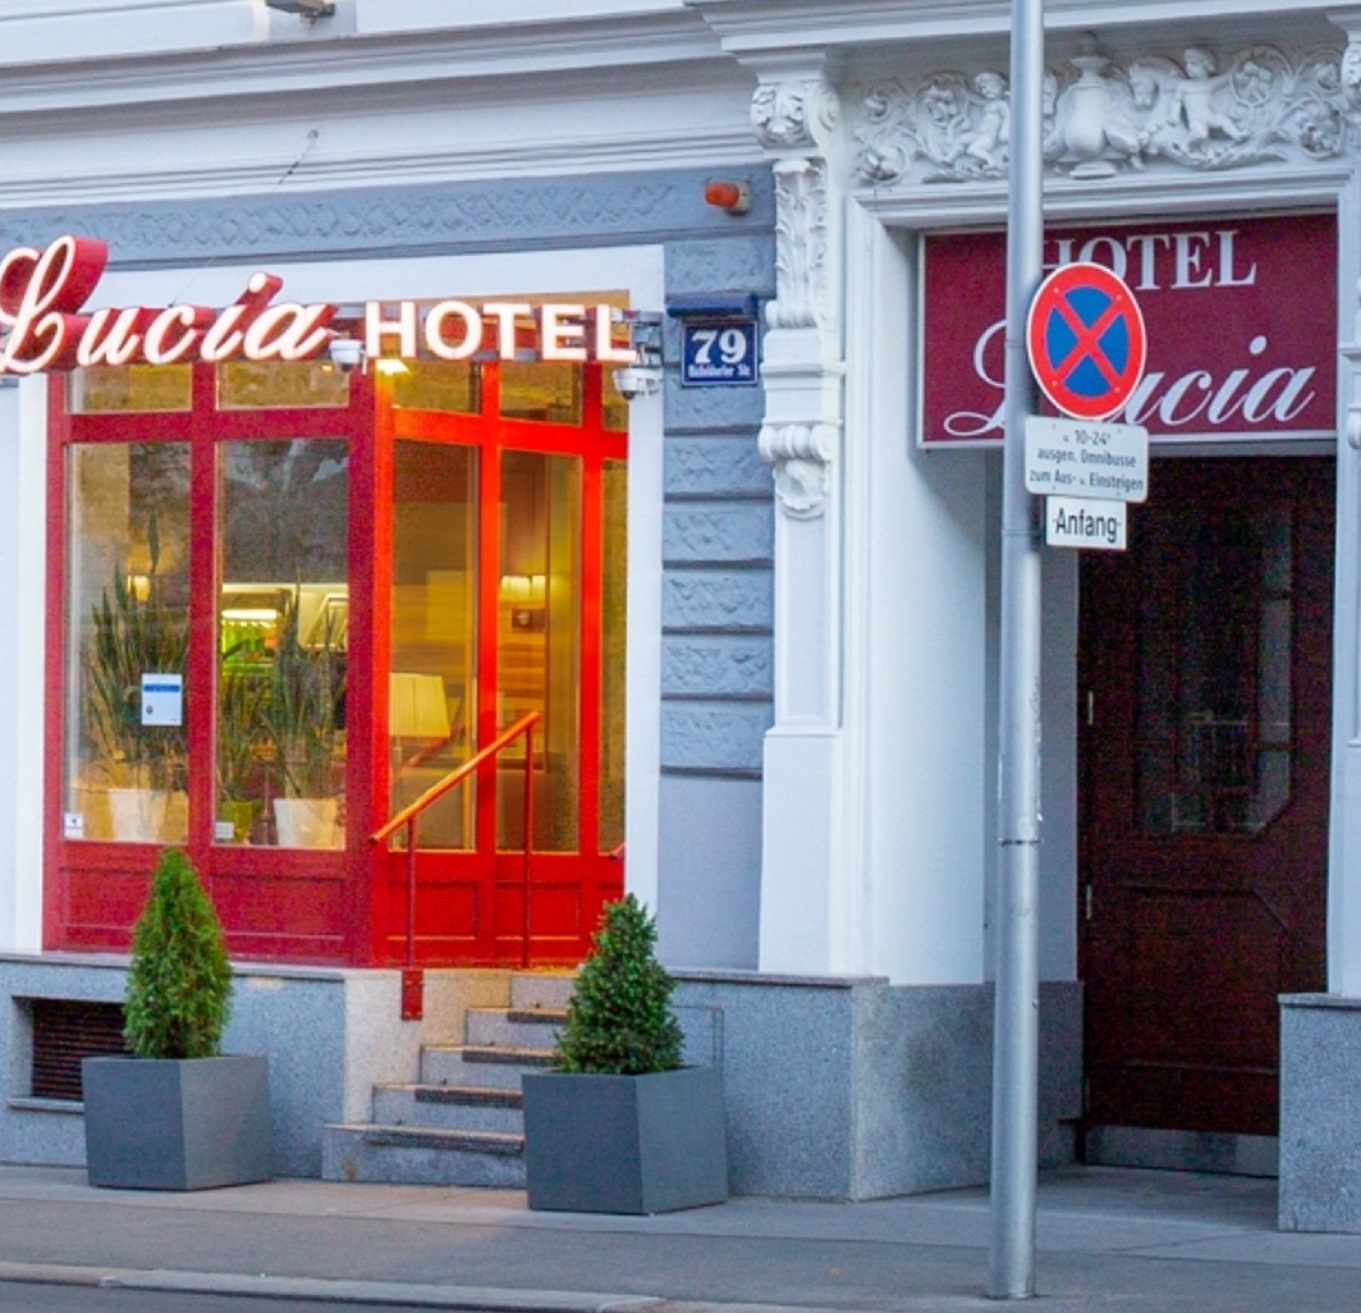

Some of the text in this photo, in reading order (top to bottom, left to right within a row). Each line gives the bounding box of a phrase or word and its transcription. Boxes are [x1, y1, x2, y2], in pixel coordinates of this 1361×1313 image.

[365, 300, 637, 361] HOTEL
[691, 329, 747, 364] 79
[1080, 448, 1137, 468] Omnibusse
[1088, 471, 1144, 493] Einsteigen
[1055, 507, 1118, 544] Anfang
